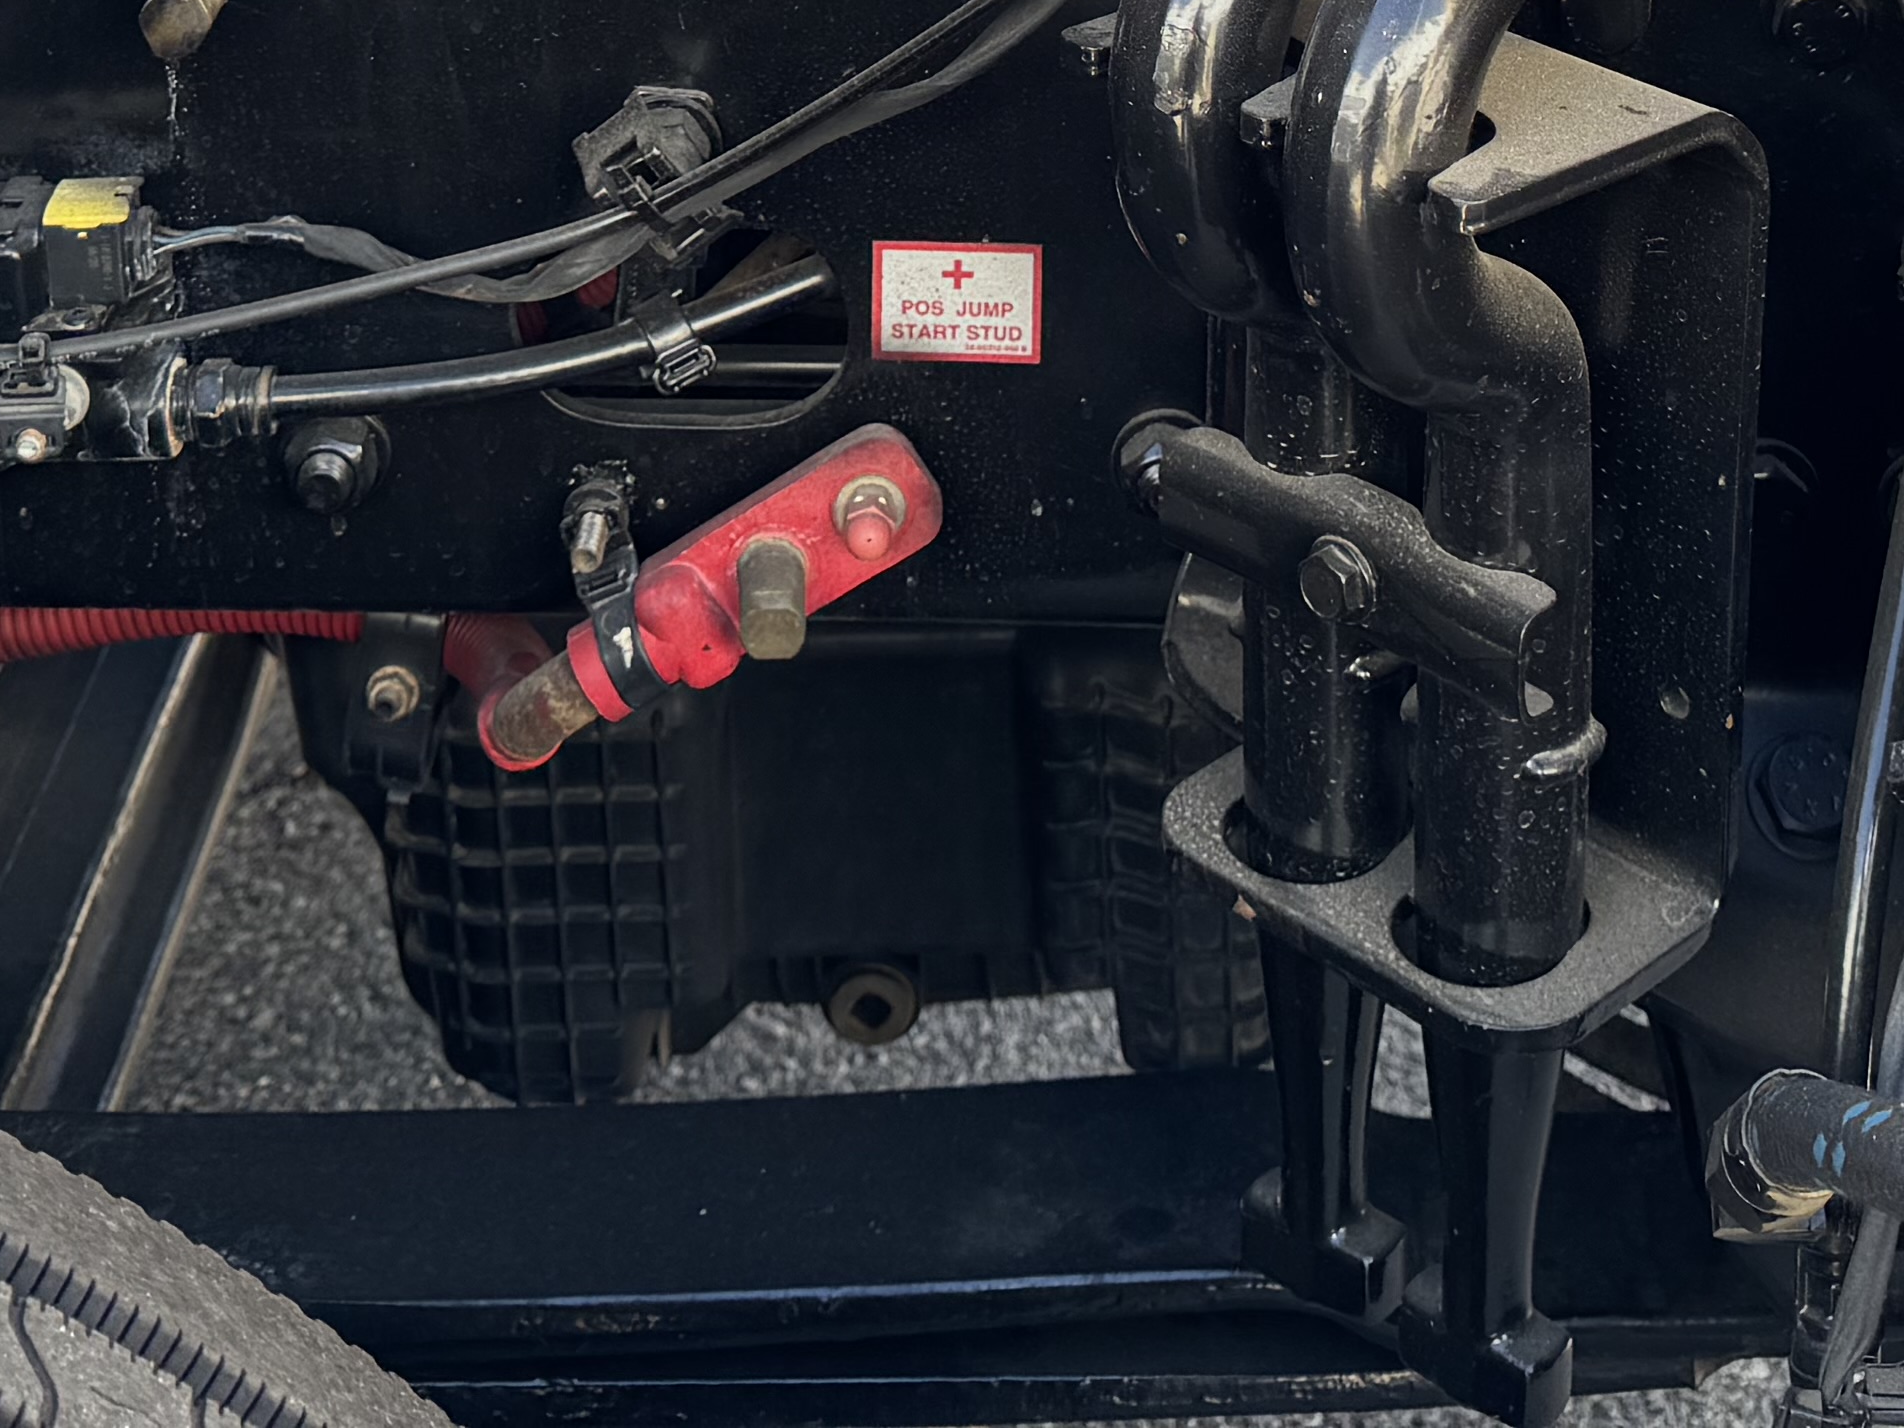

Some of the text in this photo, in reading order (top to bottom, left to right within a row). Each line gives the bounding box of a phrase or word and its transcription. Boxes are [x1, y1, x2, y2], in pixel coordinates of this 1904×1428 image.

[901, 299, 1014, 318] POS JUMP
[891, 323, 1023, 342] START STUD
